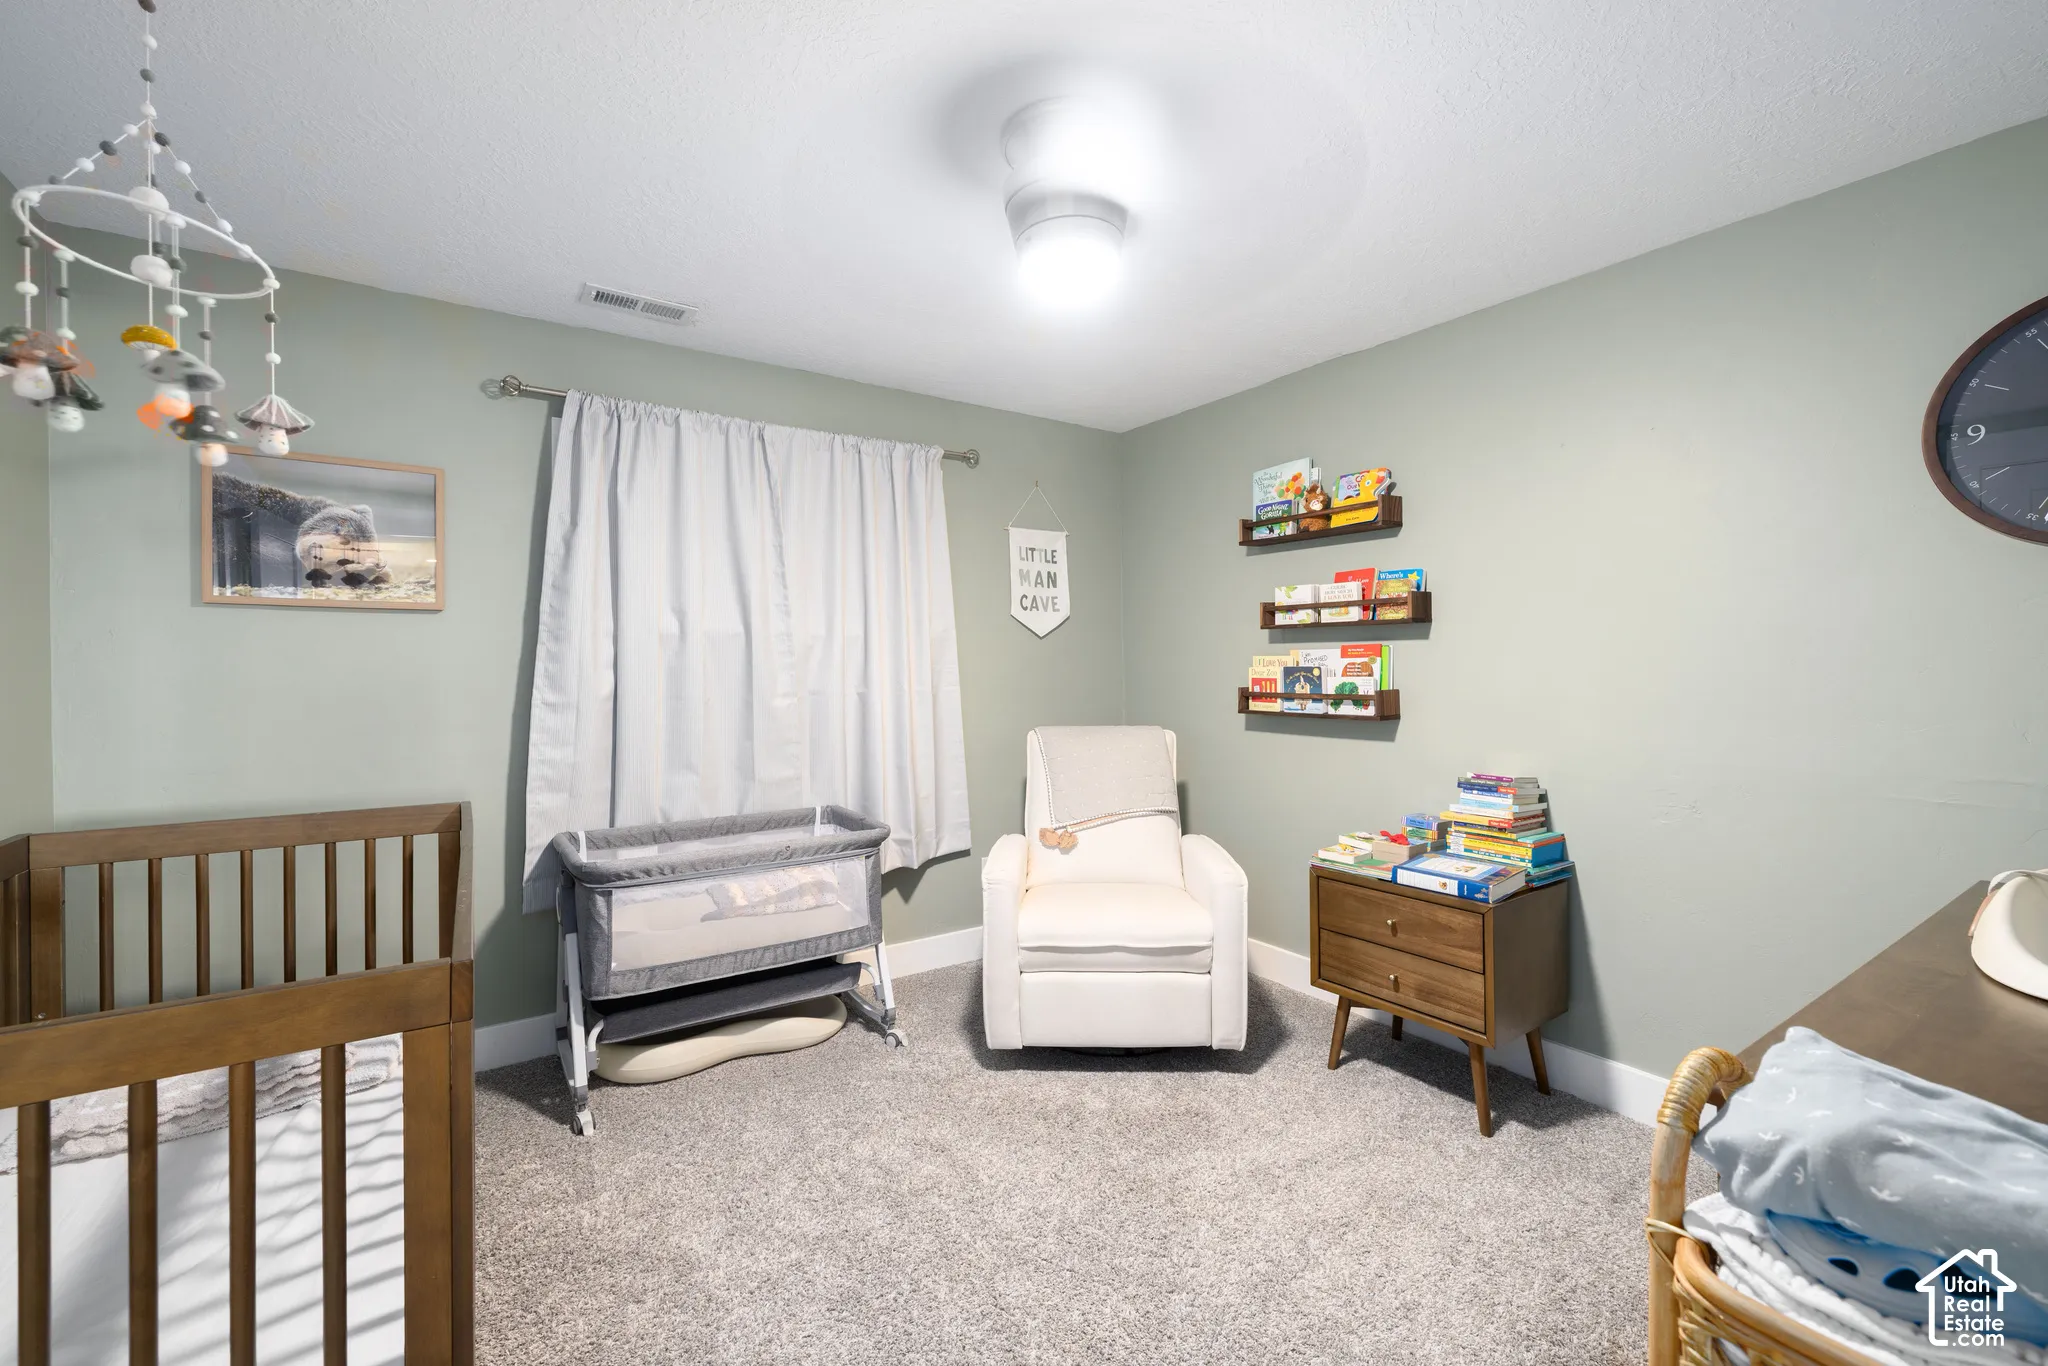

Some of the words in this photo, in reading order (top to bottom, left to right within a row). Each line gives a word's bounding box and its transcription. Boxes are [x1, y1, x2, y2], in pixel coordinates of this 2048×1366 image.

[2025, 327, 2038, 339] 55
[1968, 377, 1980, 388] 50
[1951, 432, 1959, 441] 45
[1966, 424, 1986, 446] 9
[1969, 480, 1980, 489] 40
[2026, 512, 2039, 521] 35
[1018, 546, 1058, 564] LITTLE
[1019, 569, 1058, 589] MAN
[1020, 594, 1060, 612] CAVE
